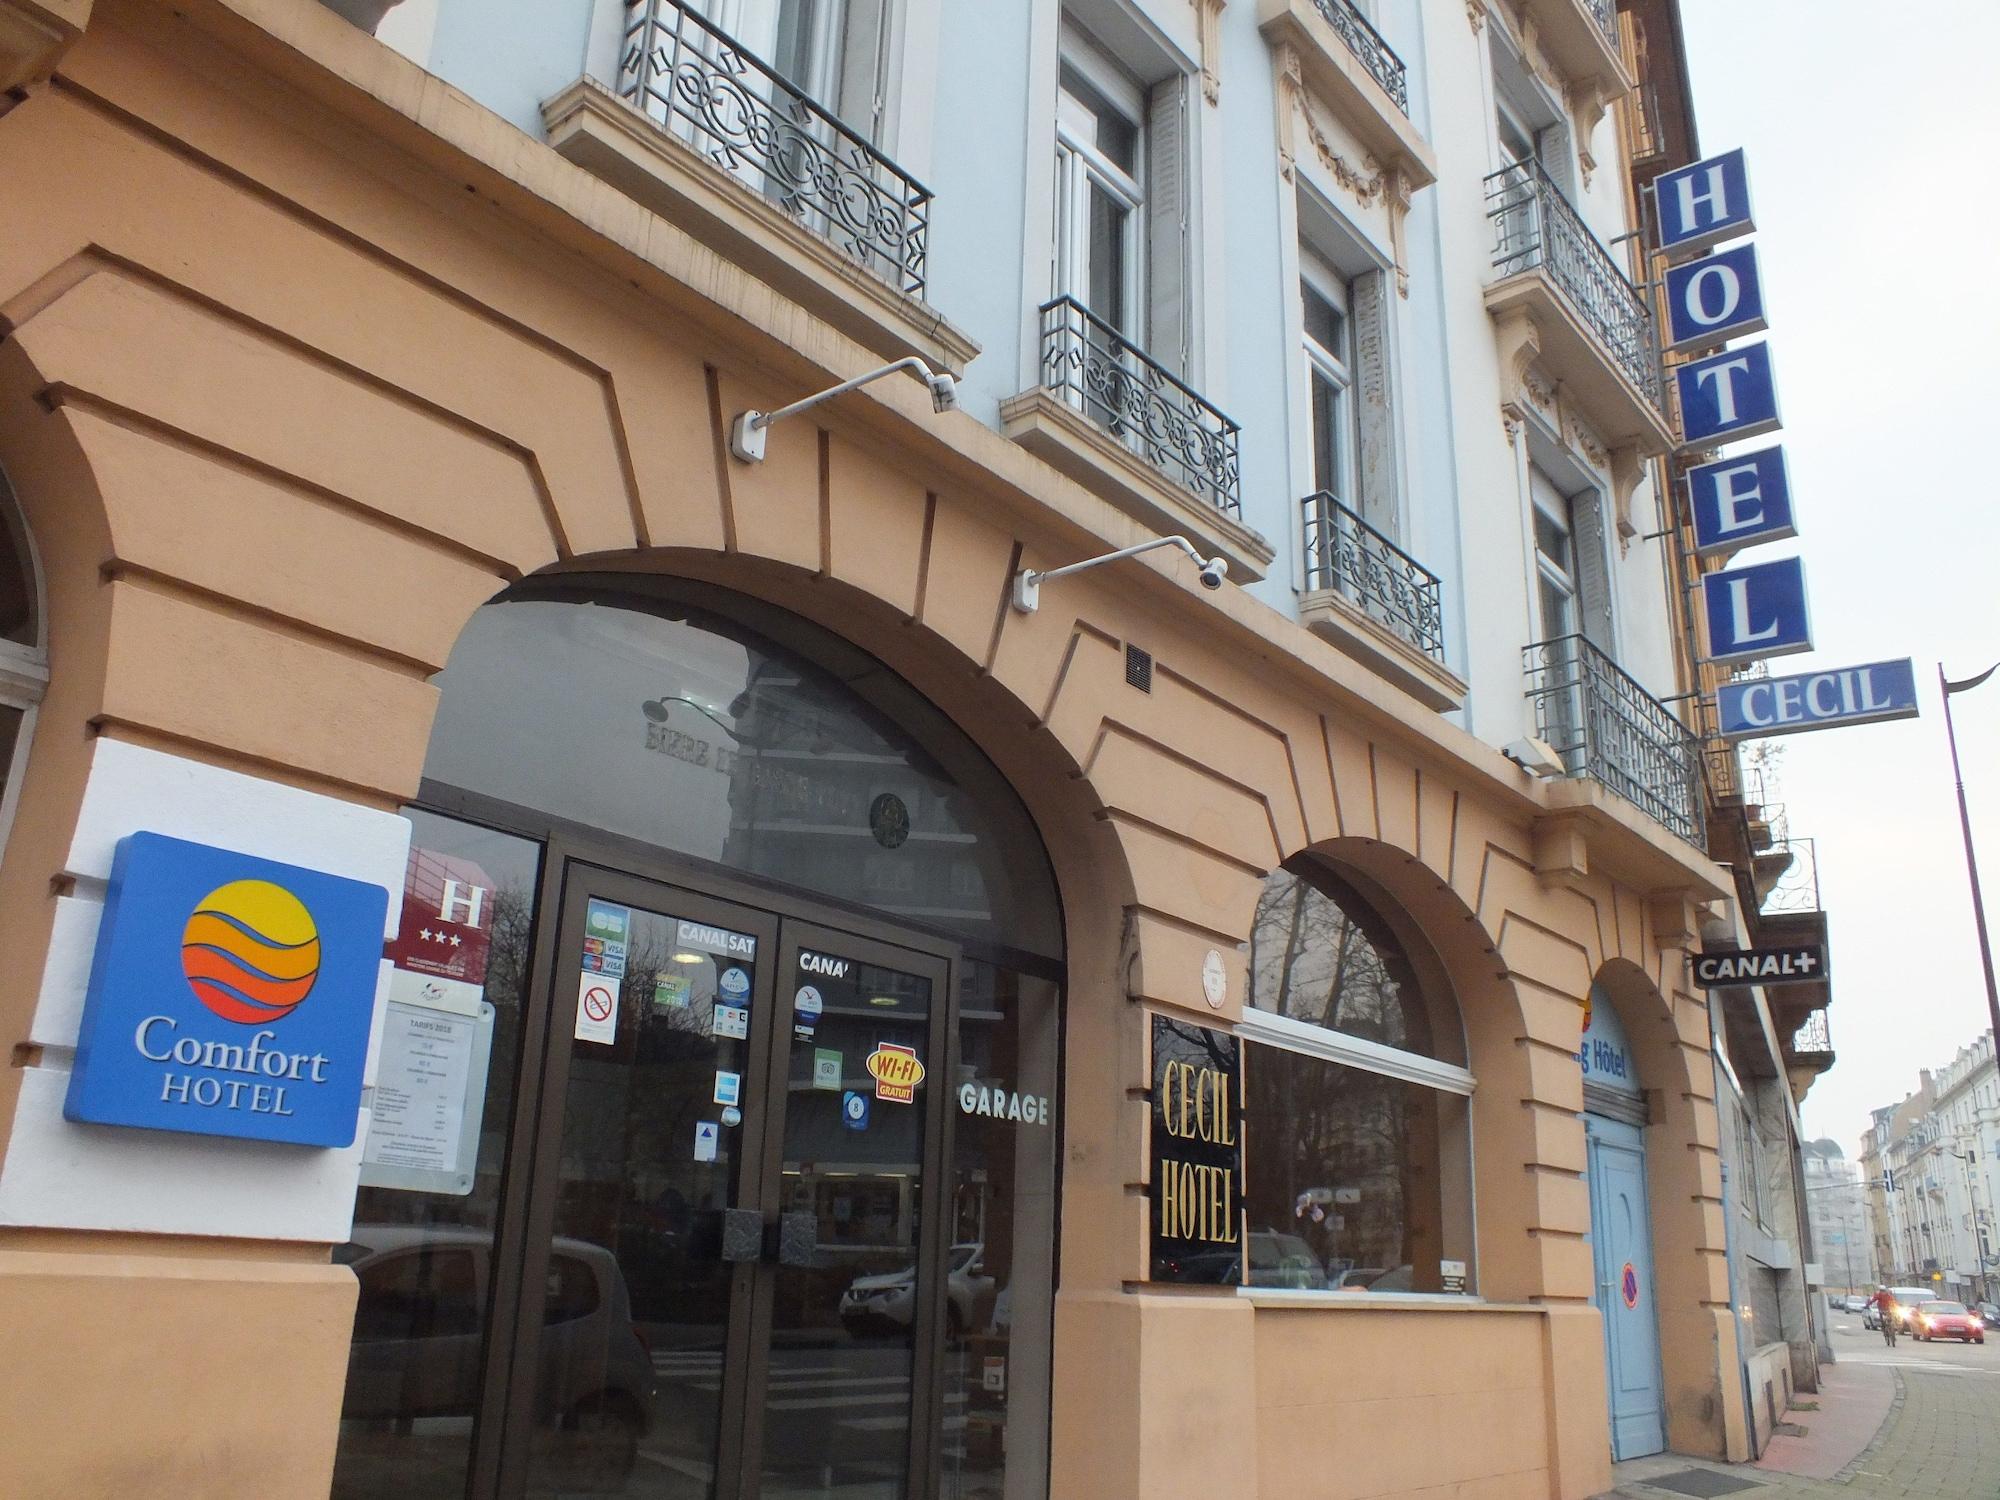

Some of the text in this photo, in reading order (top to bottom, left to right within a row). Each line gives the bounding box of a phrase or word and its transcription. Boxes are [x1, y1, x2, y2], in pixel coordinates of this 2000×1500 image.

[1674, 163, 1779, 646] HOTEL
[1740, 668, 1891, 727] CECIL
[435, 878, 487, 930] H
[606, 960, 622, 971] VISA
[607, 943, 624, 955] VISA
[1698, 952, 1817, 981] CANAL+
[134, 1015, 331, 1085] Comfort
[876, 1054, 917, 1081] WI-FI
[1592, 1038, 1627, 1079] Hôtel
[159, 1072, 295, 1118] HOTEL
[879, 1084, 912, 1100] GRATUIT
[960, 1082, 1049, 1126] GARAGE
[1162, 1060, 1236, 1148] CECIL
[1160, 1158, 1239, 1244] HOTEL
